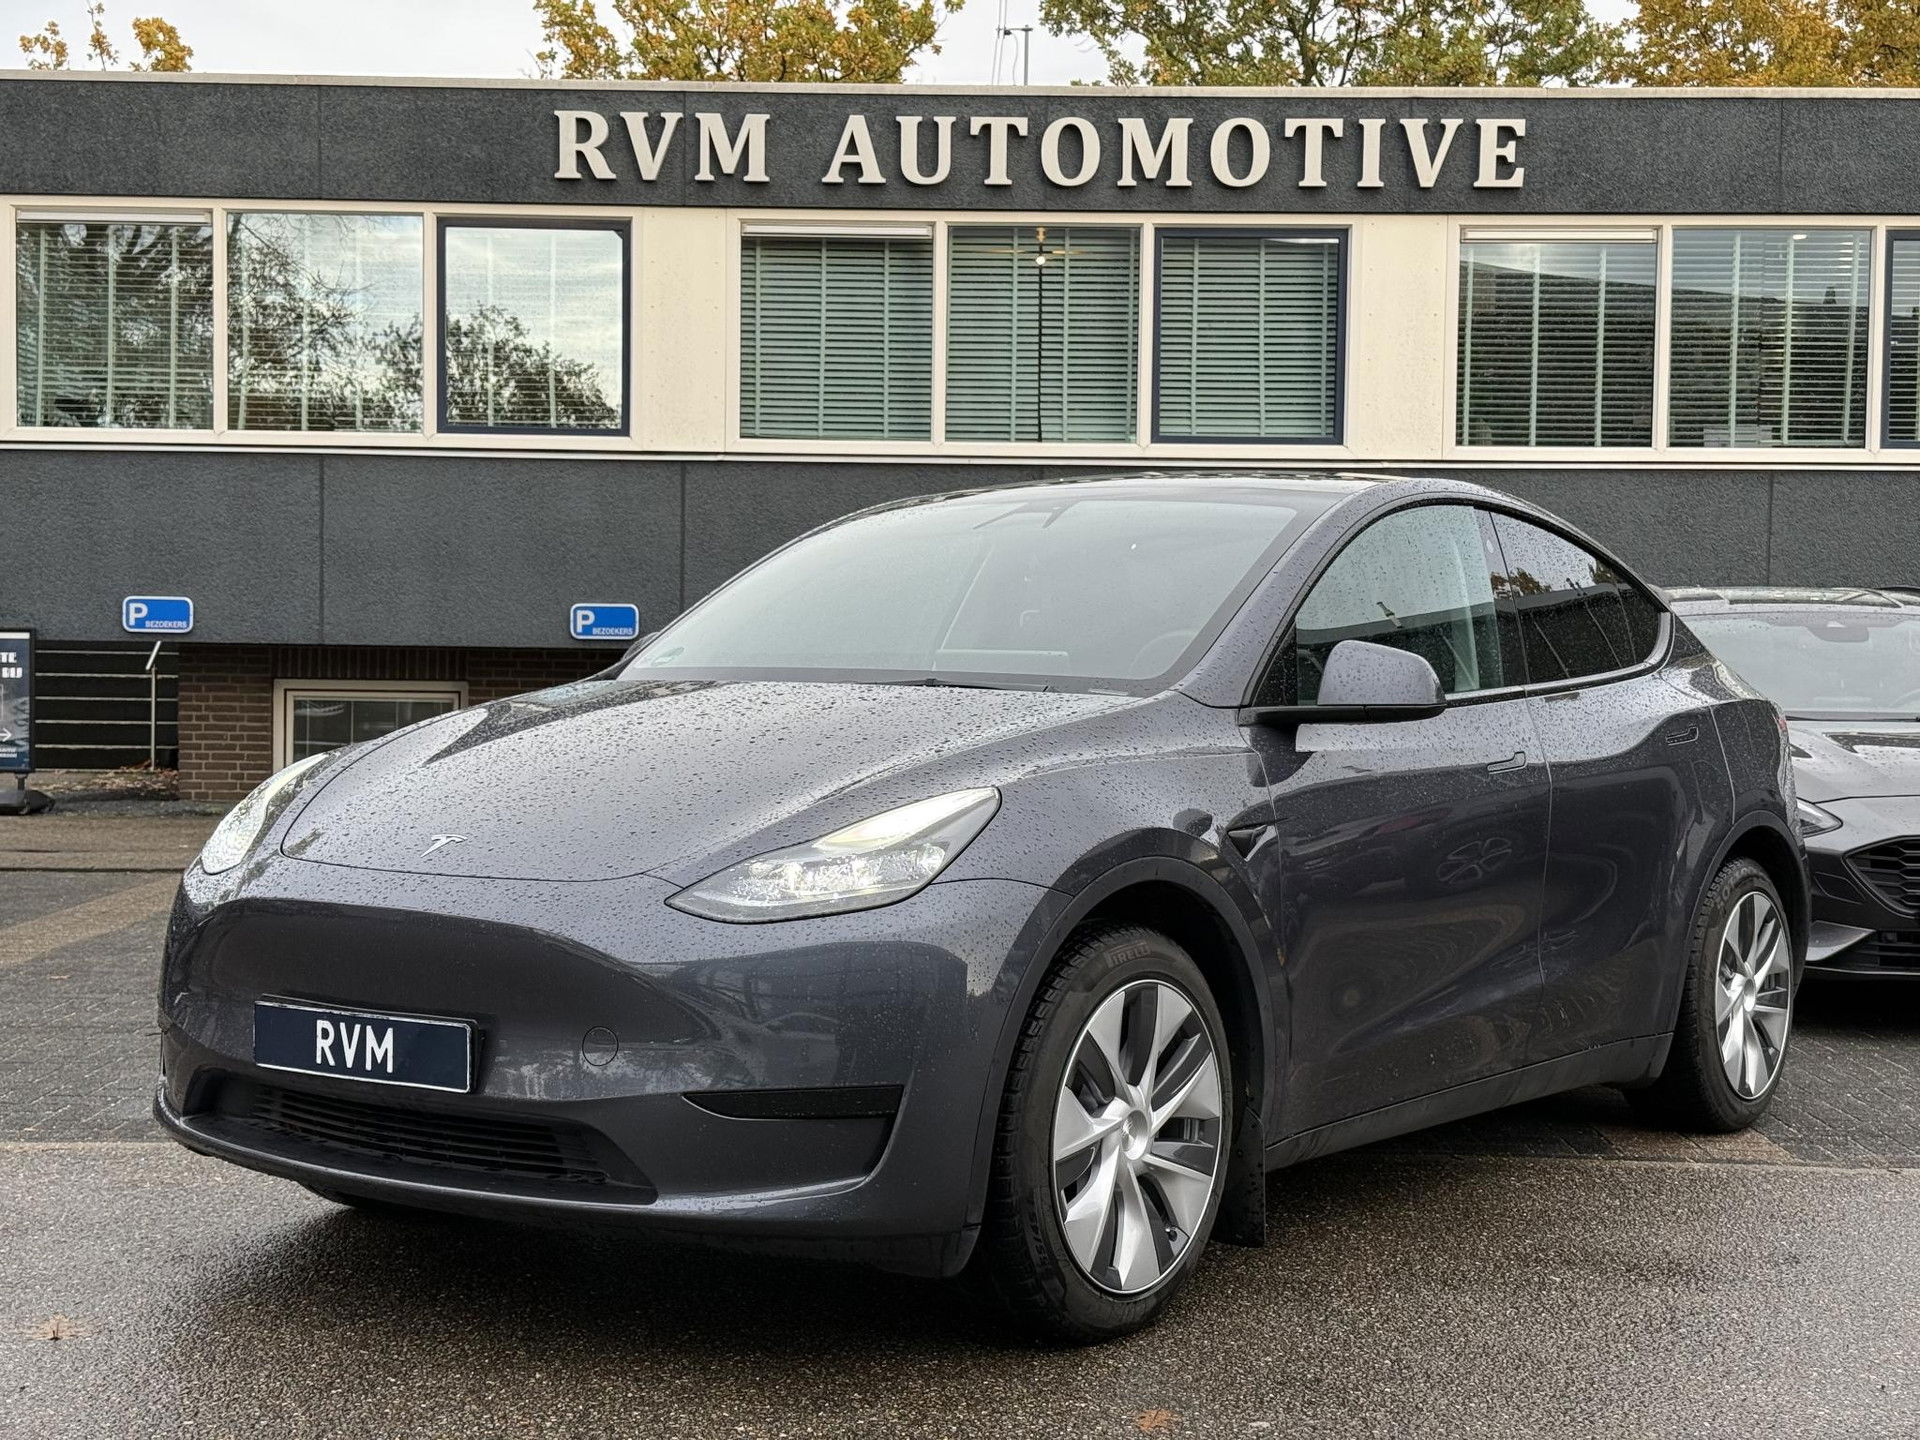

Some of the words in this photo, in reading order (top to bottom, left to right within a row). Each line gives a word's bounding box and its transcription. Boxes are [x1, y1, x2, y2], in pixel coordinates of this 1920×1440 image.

[554, 110, 770, 182] RVM
[822, 115, 1527, 188] AUTOMOTIVE
[129, 603, 148, 626] P
[145, 620, 187, 628] BEZOEKERS
[576, 610, 595, 633] P
[315, 1020, 393, 1073] RVM
